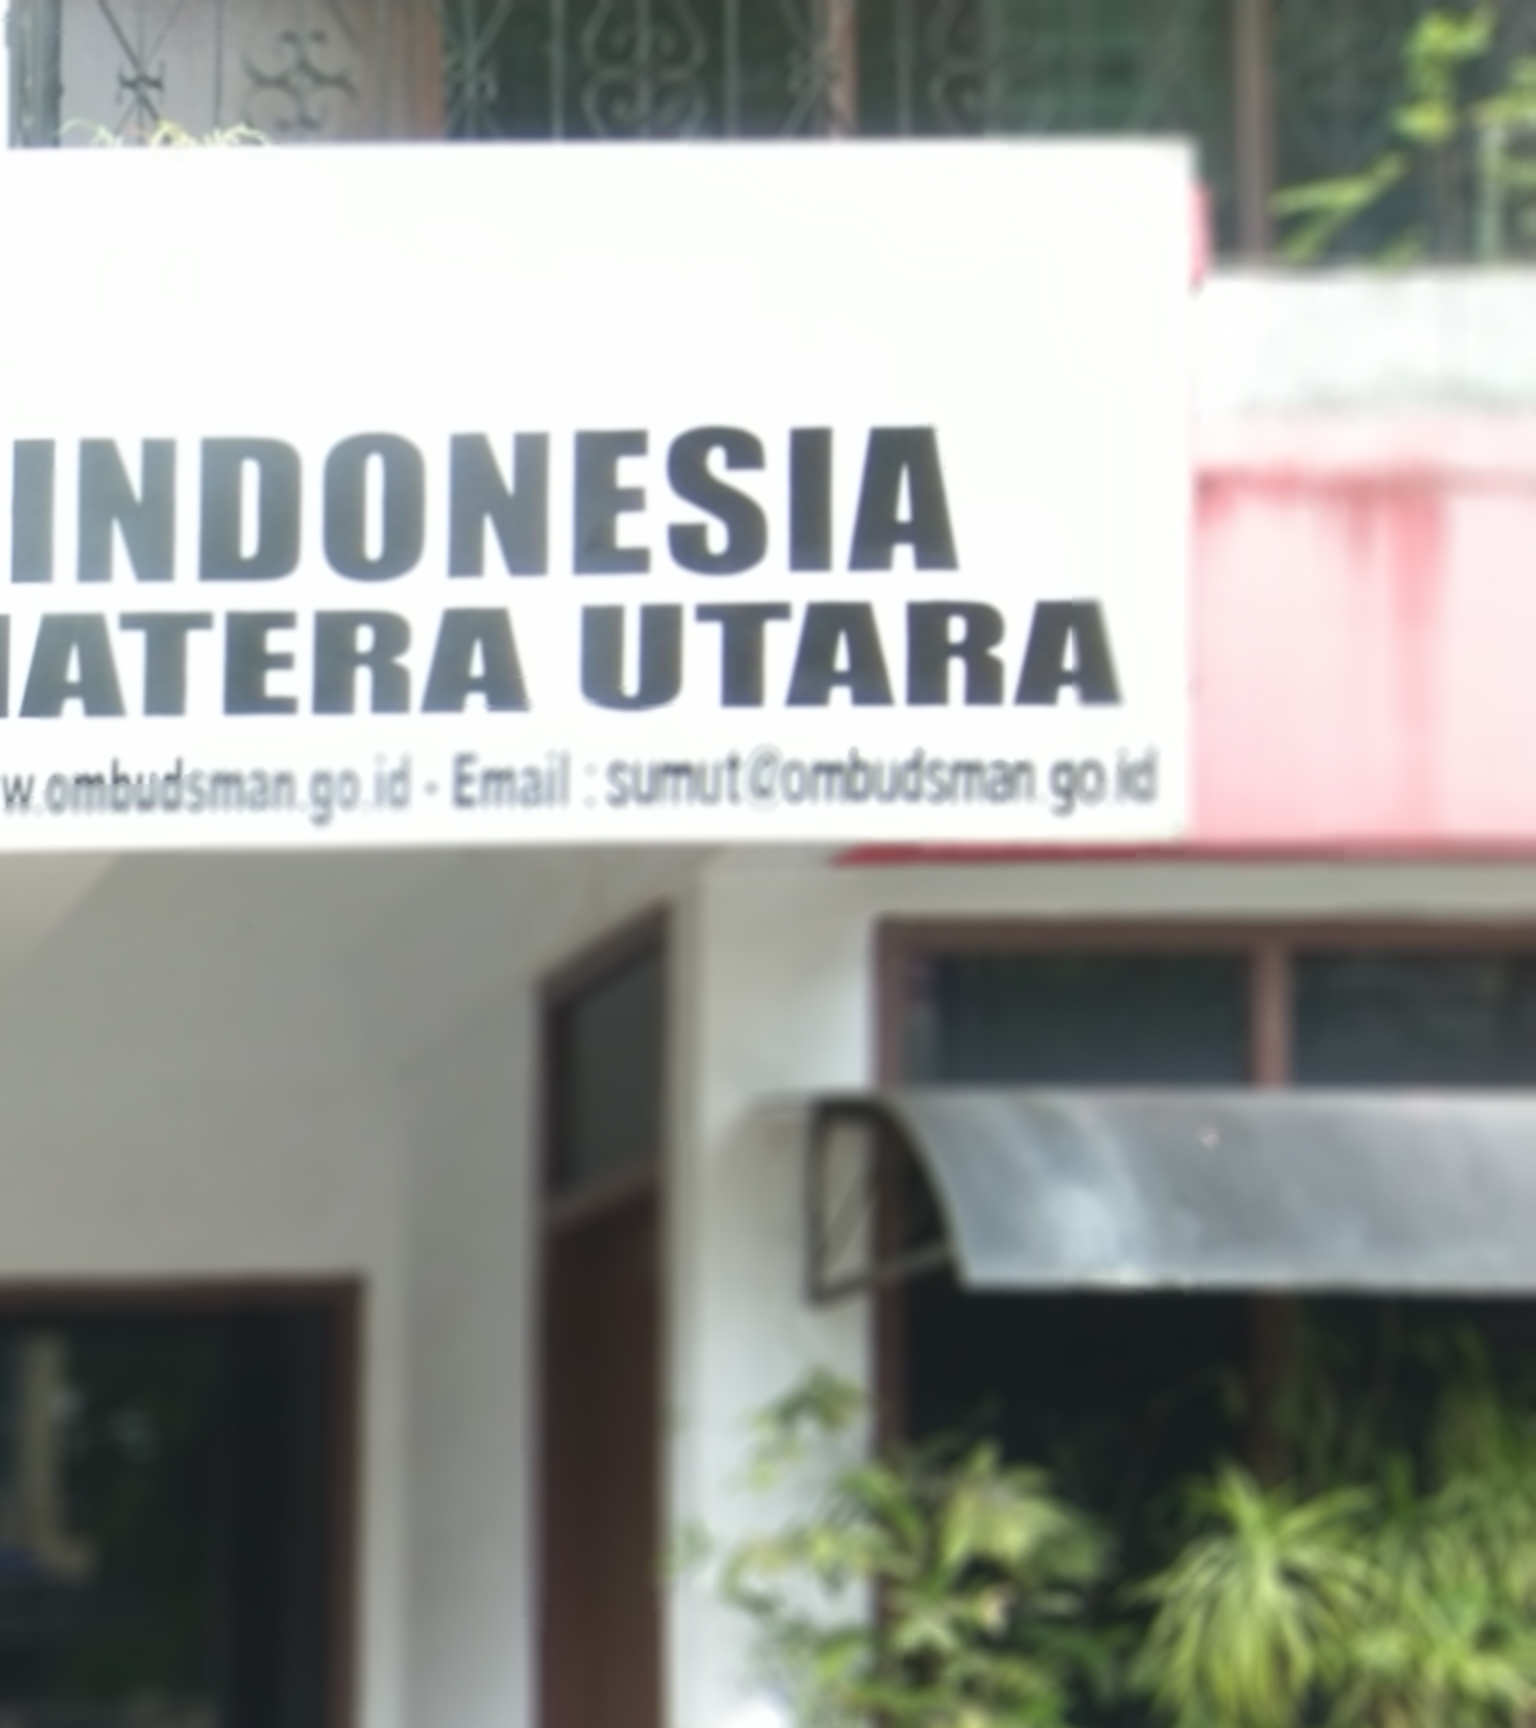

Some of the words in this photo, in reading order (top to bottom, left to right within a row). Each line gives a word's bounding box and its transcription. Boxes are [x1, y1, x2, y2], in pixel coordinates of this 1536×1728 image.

[10, 424, 960, 587] INDONESIA
[578, 597, 1124, 713] UTARA
[451, 751, 572, 812] Email
[604, 744, 1158, 816] sumut@ombudsman.go.id
